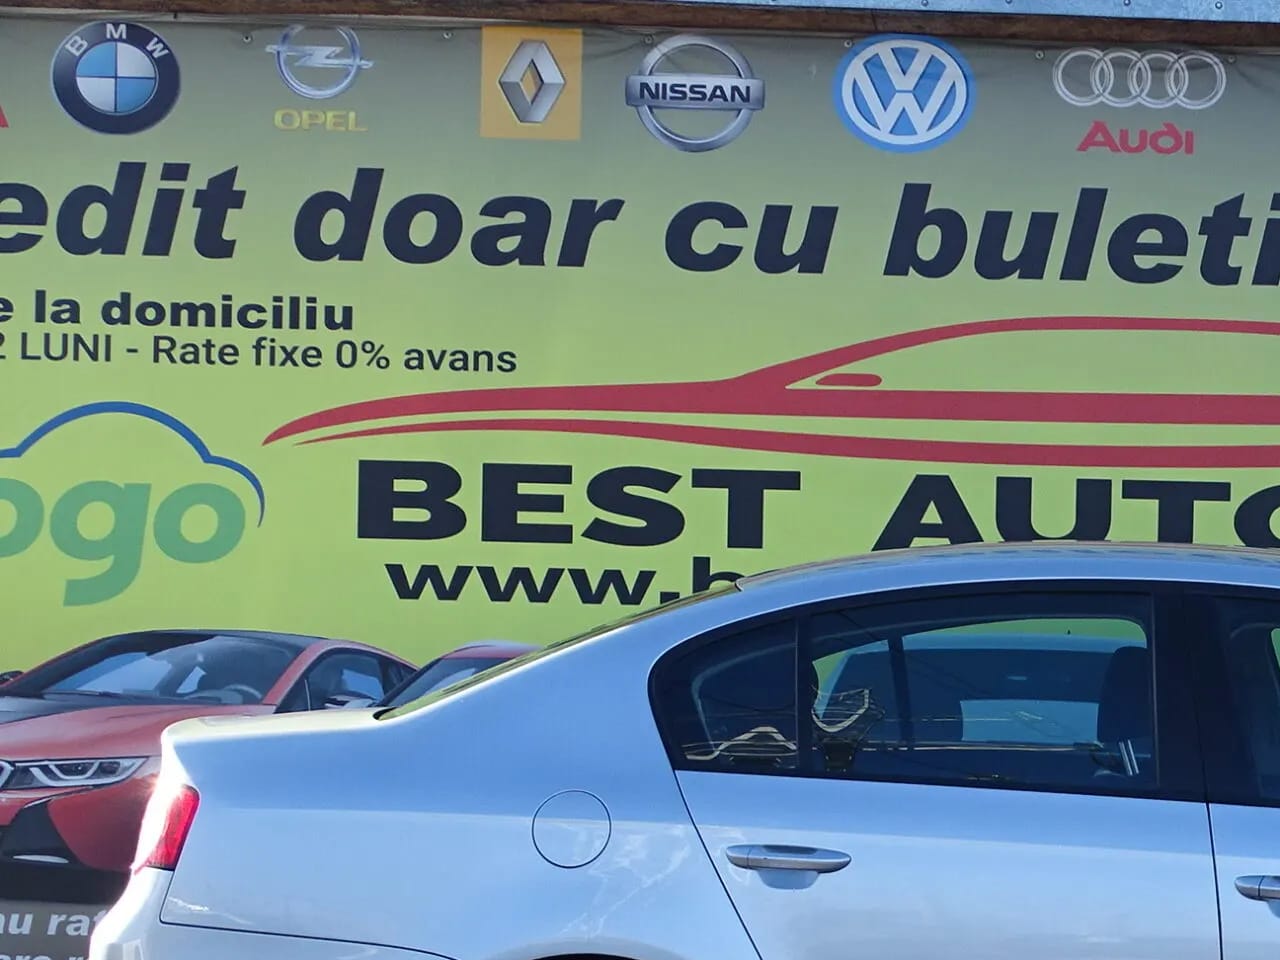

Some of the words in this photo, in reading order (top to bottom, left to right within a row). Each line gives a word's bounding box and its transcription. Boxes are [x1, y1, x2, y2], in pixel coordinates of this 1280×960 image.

[65, 23, 169, 59] BMW
[639, 82, 751, 103] NISSAN
[273, 109, 368, 131] OPEL
[1076, 121, 1194, 154] Audi
[294, 168, 625, 267] doar
[665, 202, 839, 274] cu
[35, 290, 80, 324] la
[101, 292, 352, 330] domiciliu
[21, 332, 111, 362] LUNI
[153, 336, 239, 365] Rate
[252, 337, 322, 367] fixe
[337, 340, 389, 369] 0%
[404, 349, 516, 372] avans
[358, 460, 801, 549] BEST
